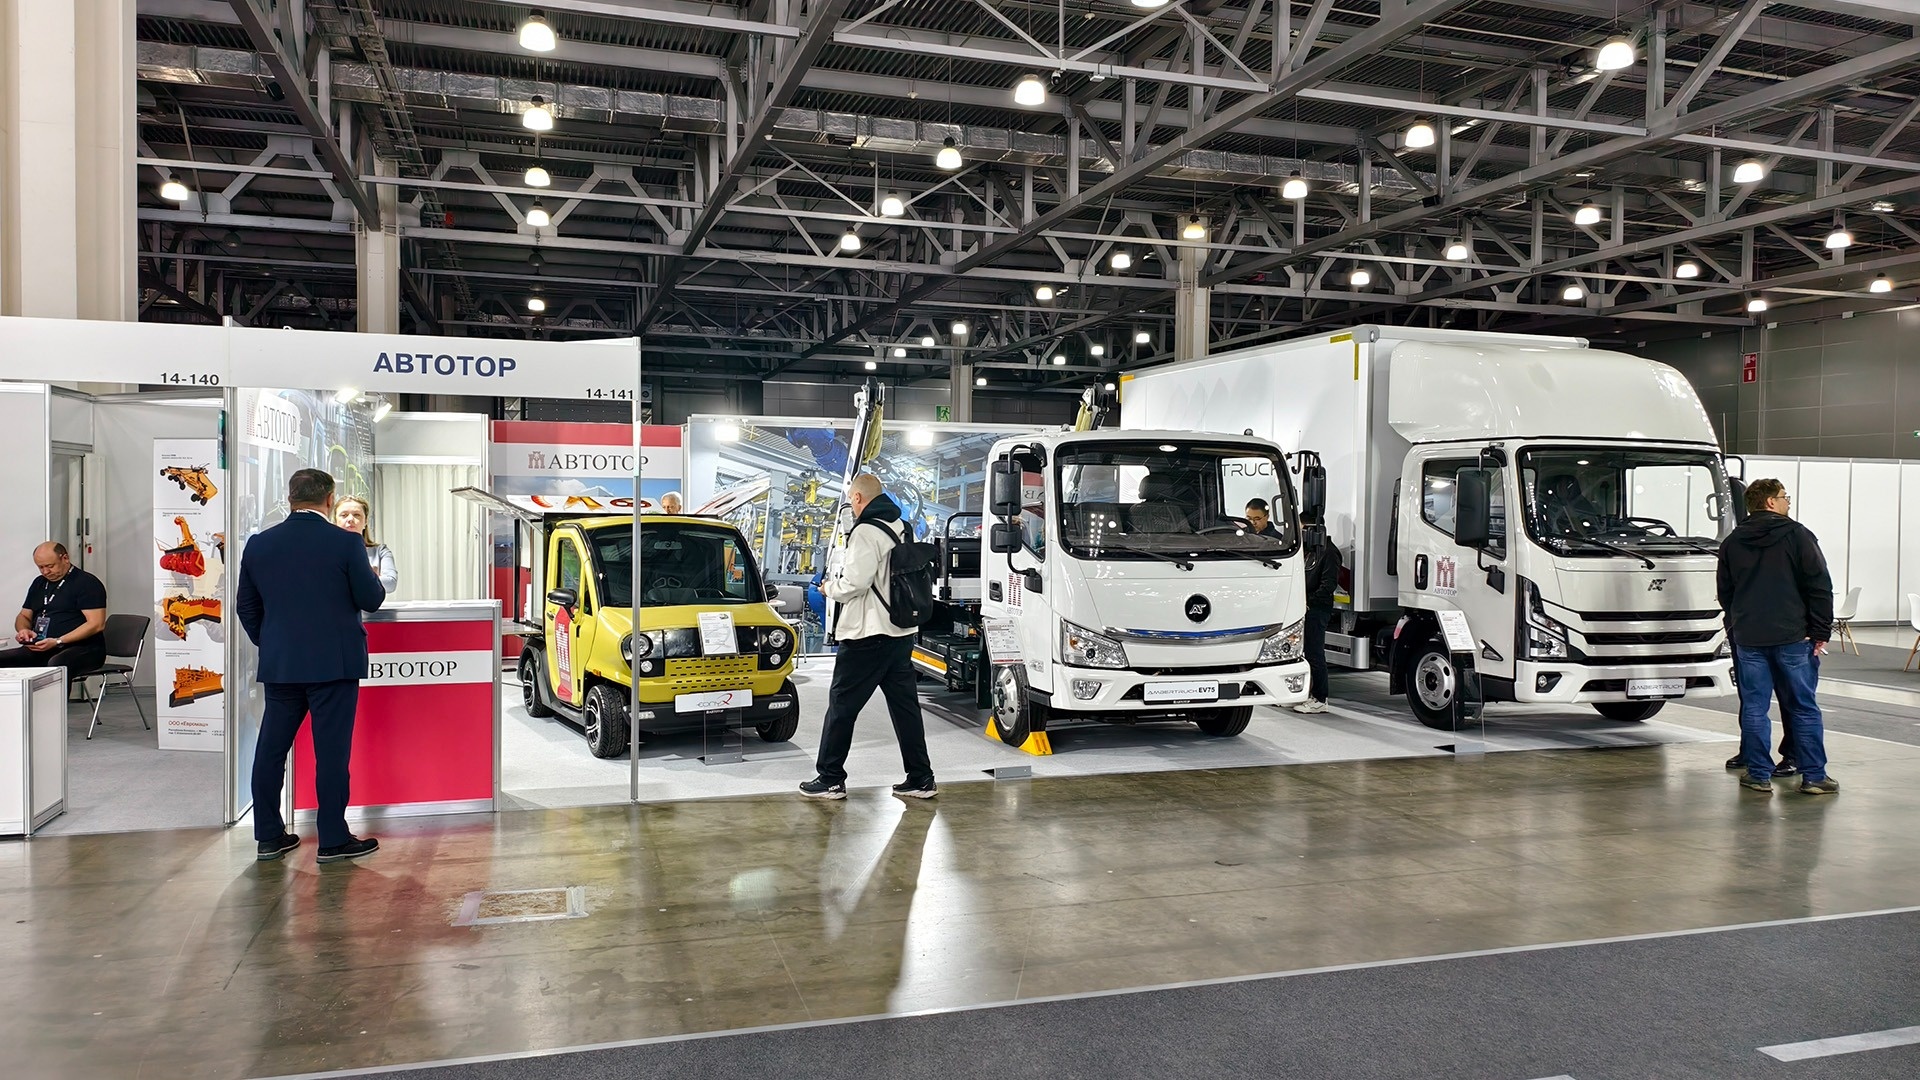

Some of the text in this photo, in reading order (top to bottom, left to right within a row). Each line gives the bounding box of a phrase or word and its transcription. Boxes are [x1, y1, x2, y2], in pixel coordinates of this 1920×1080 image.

[373, 352, 517, 377] АВТОТОР
[160, 373, 220, 386] 14-140
[585, 388, 634, 400] 14-141
[256, 404, 297, 447] АВТОТОР
[369, 660, 458, 679] ВТОТОР
